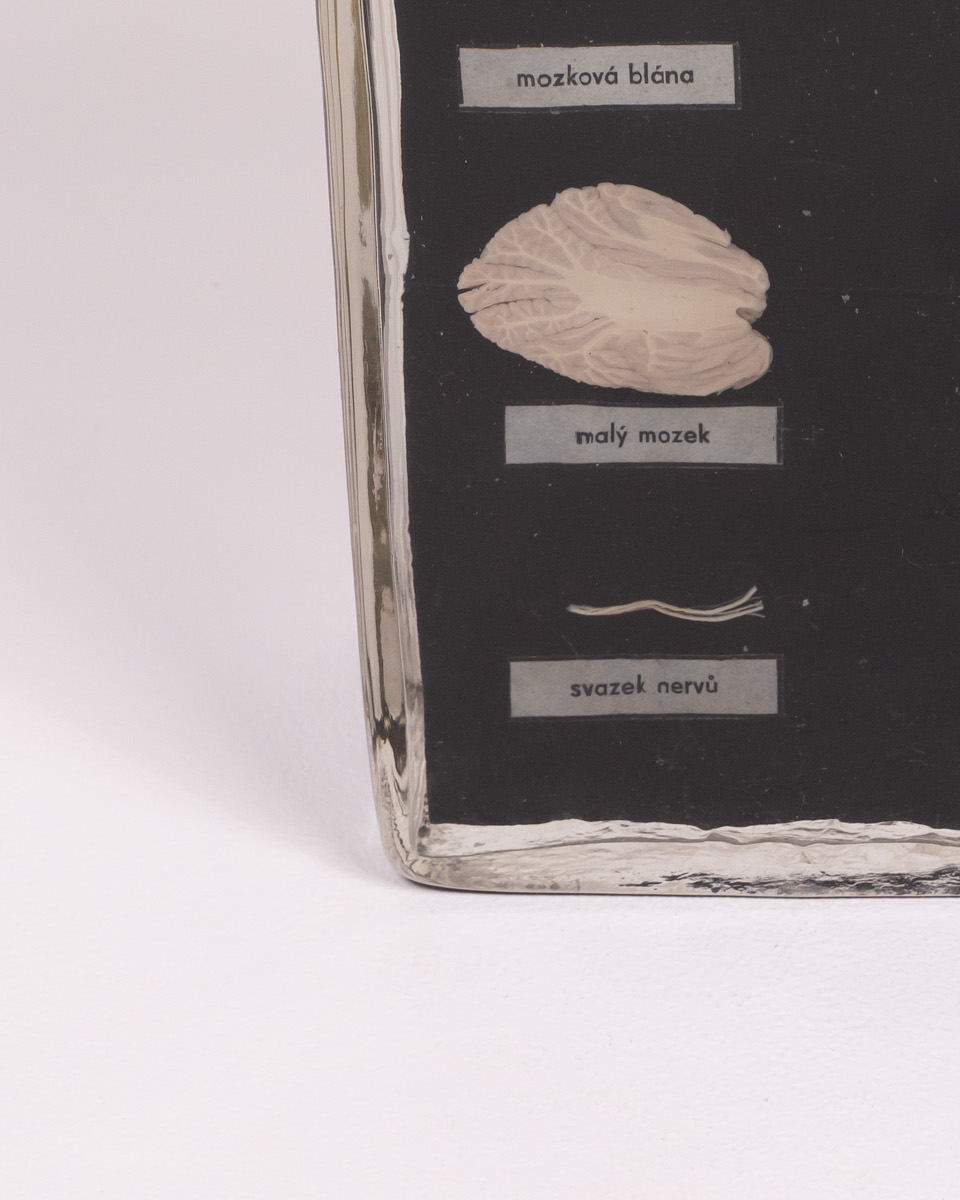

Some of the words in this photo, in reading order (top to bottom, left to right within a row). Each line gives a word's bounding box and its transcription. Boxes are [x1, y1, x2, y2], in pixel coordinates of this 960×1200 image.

[516, 64, 618, 88] mozková
[628, 61, 694, 85] blána
[575, 422, 628, 449] malý
[638, 422, 710, 444] mozek
[570, 674, 646, 698] svazek
[657, 673, 718, 695] nervů
